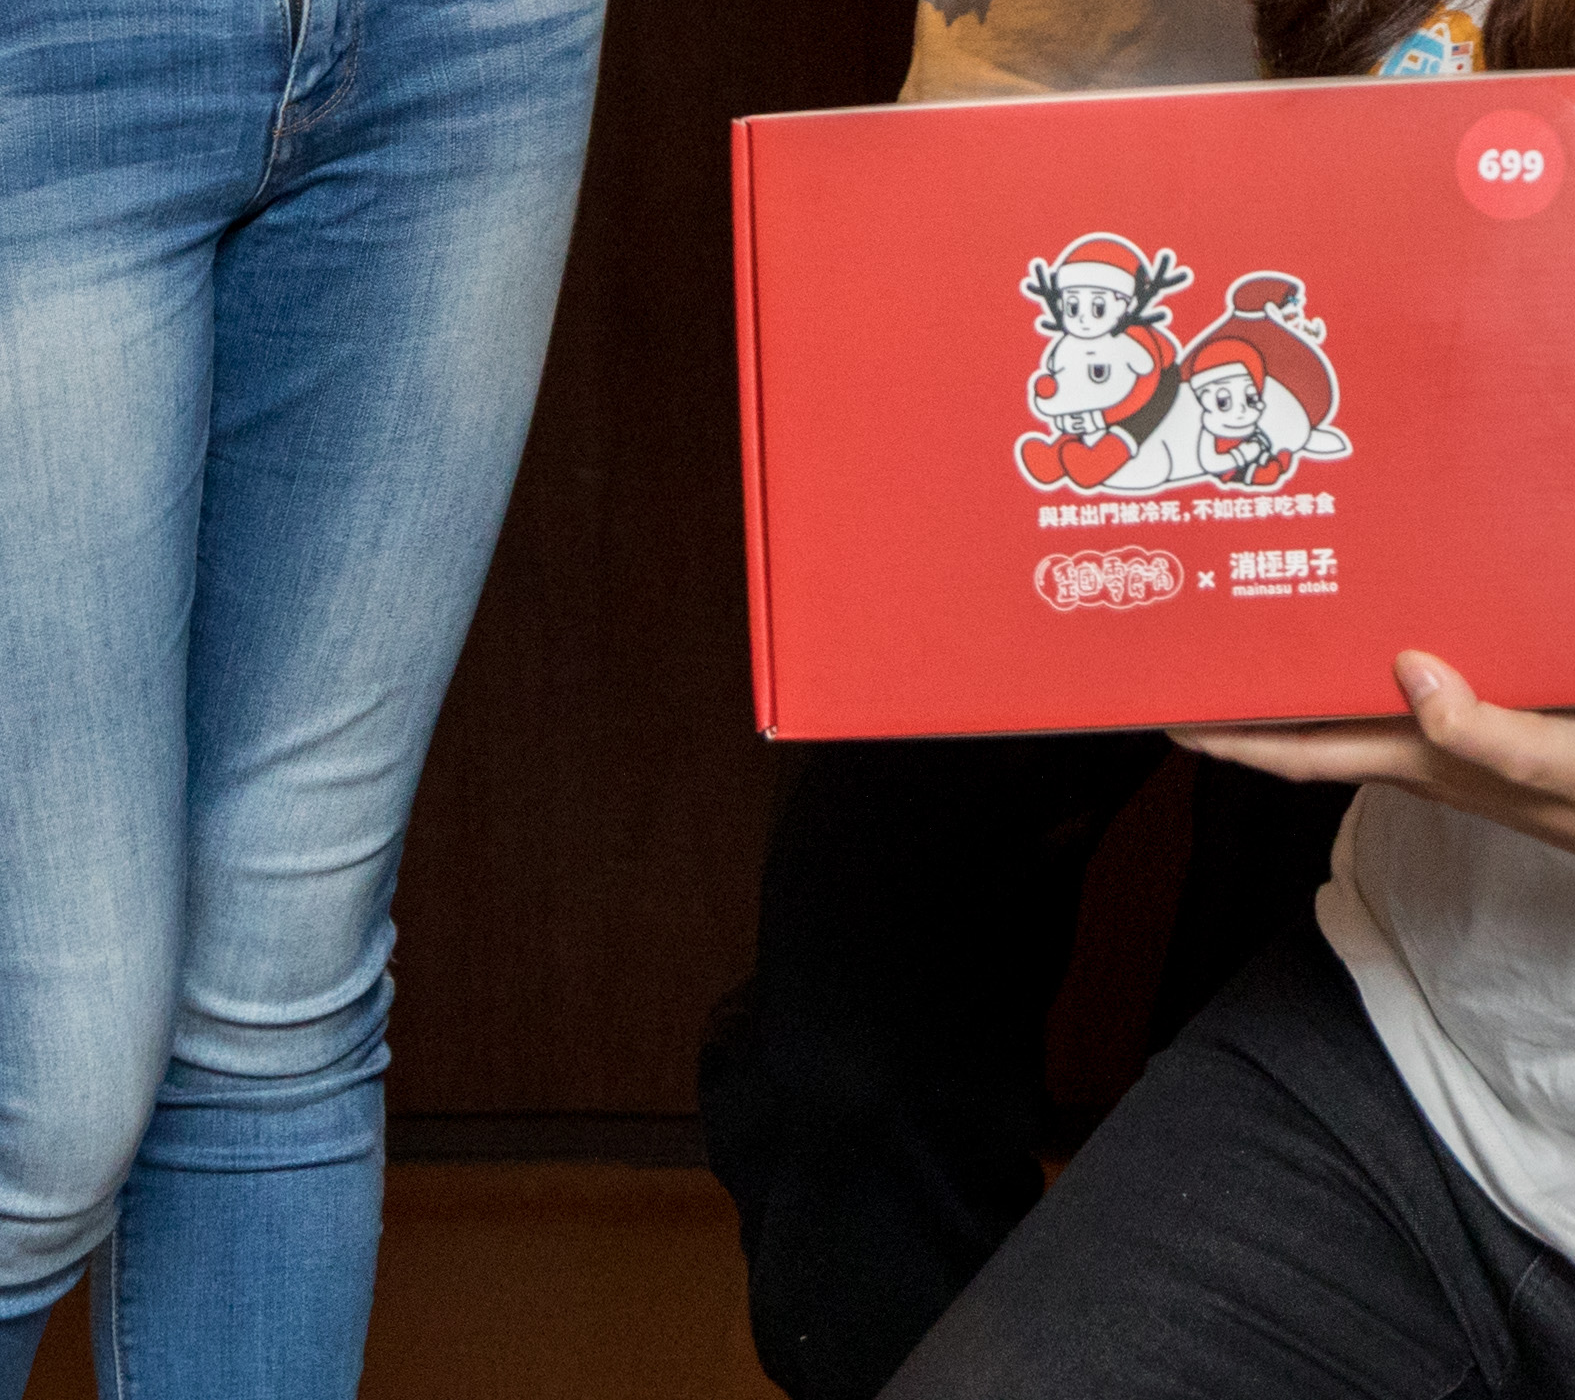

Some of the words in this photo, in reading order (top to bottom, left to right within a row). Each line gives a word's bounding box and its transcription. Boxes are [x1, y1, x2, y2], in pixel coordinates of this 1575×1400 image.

[1477, 148, 1545, 183] 699
[1232, 582, 1293, 597] mainasu
[1297, 580, 1339, 594] otoko
